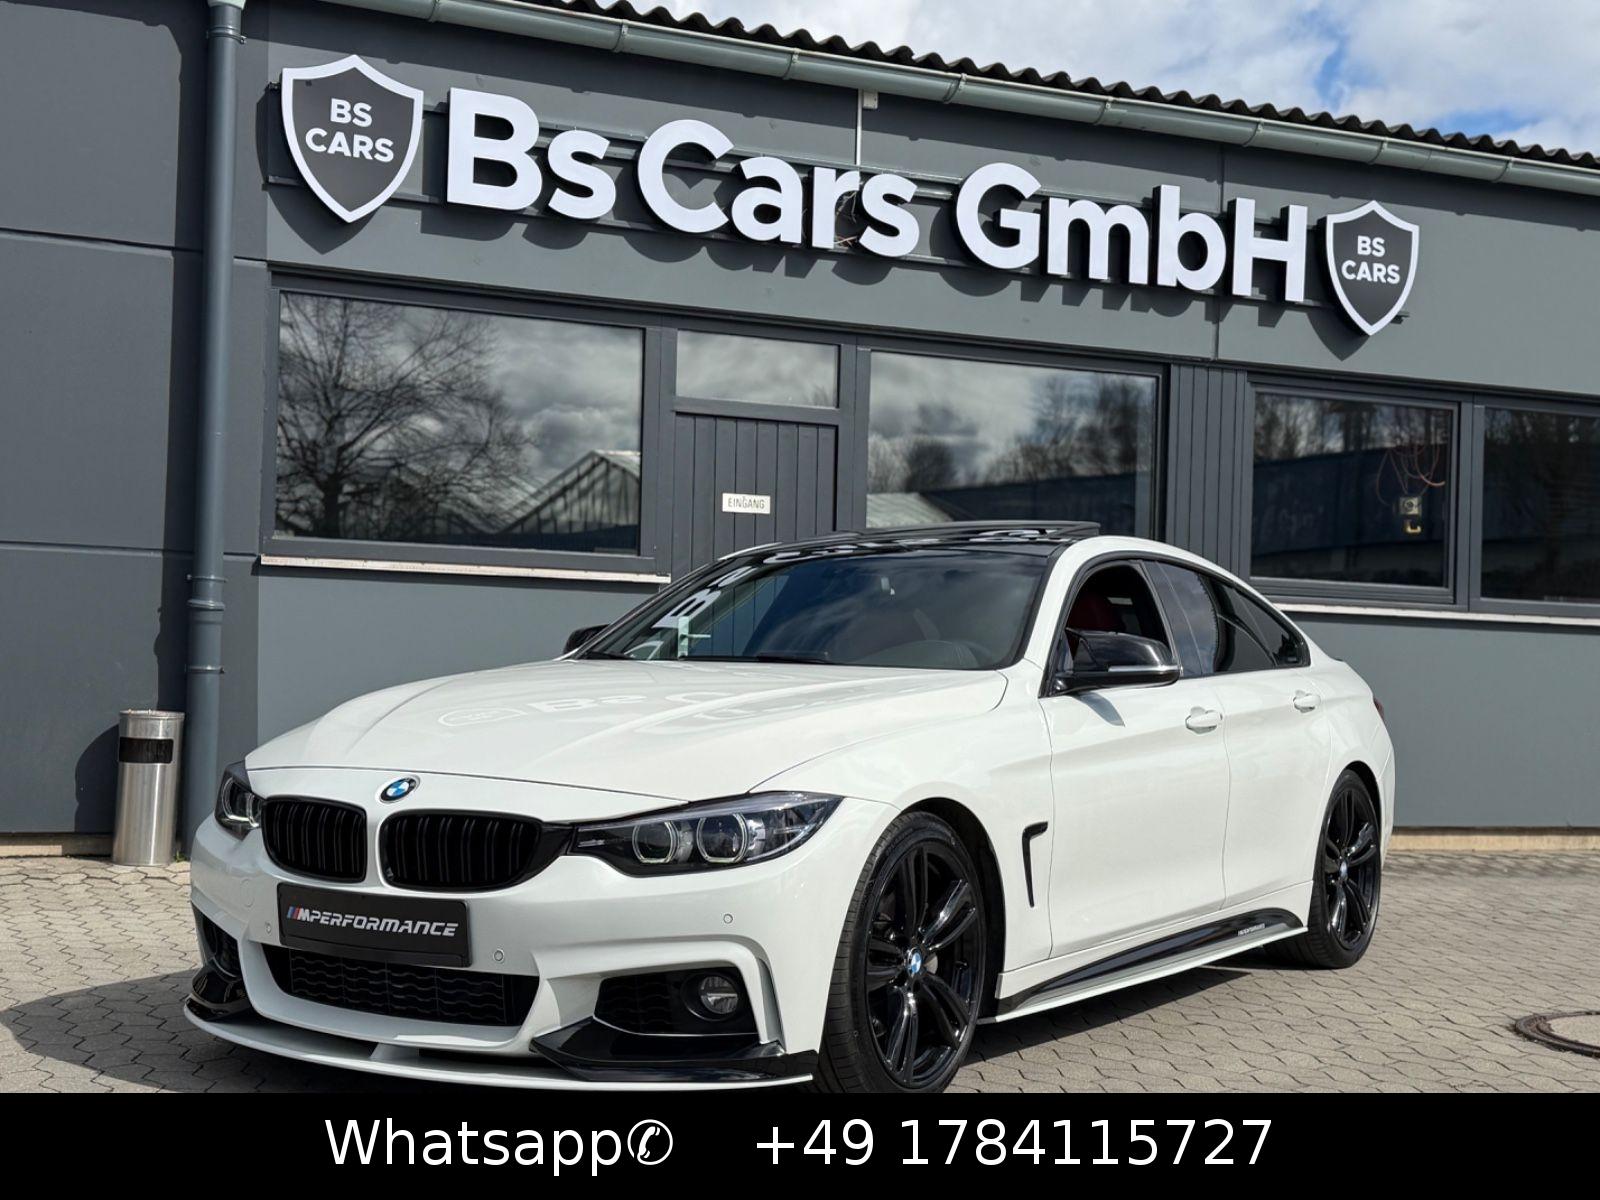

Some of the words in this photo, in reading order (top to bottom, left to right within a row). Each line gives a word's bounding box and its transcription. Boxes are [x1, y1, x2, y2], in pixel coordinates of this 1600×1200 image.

[329, 98, 372, 128] BS
[304, 127, 395, 163] CARS
[956, 162, 1308, 302] GmbH
[1357, 234, 1386, 258] BS
[1341, 259, 1401, 285] CARS
[727, 497, 766, 509] EINGANG
